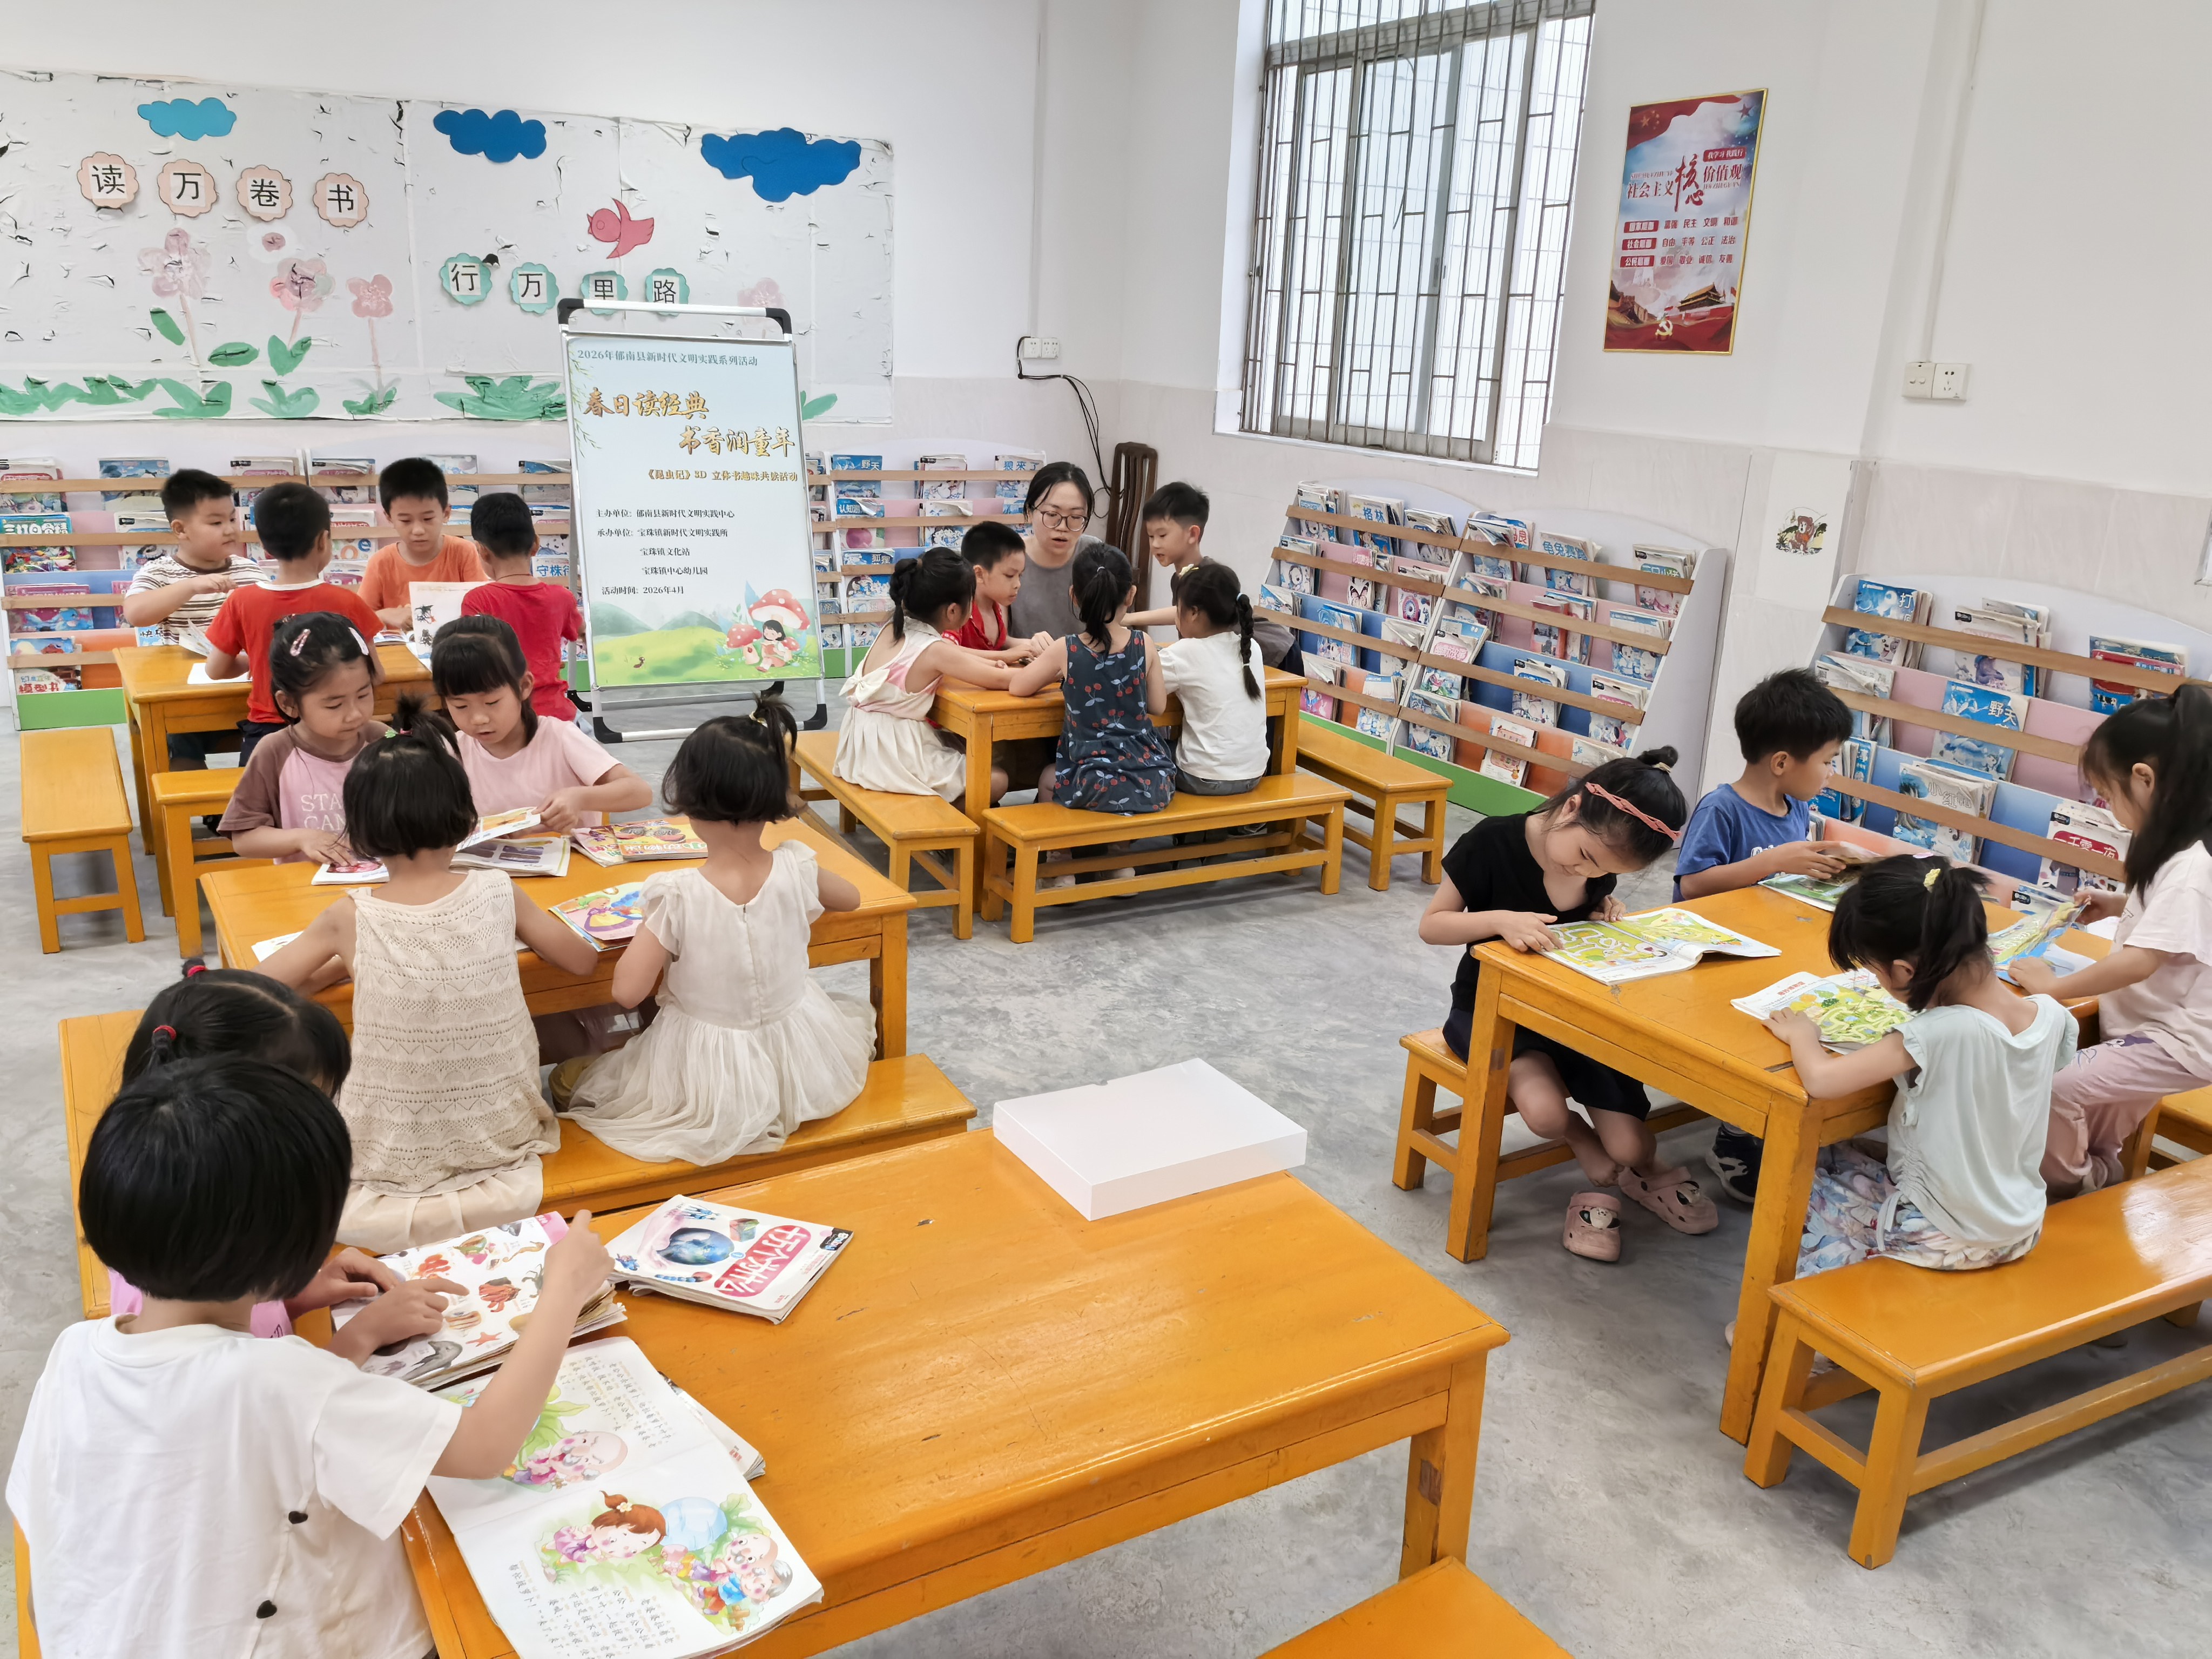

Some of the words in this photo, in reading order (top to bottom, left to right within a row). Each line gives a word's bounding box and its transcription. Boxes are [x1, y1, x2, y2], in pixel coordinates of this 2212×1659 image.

[92, 165, 354, 213] 读万卷书
[1628, 180, 1674, 199] 社会主义
[1675, 153, 1704, 212] 核心
[1703, 164, 1743, 183] 价值观
[1683, 219, 1697, 228] 民主
[1703, 218, 1718, 227] 文明
[1662, 238, 1676, 247] 自由
[1682, 237, 1696, 246] 平等
[1701, 236, 1715, 245] 公正
[1721, 235, 1736, 245] 法治
[451, 263, 677, 304] 行万里路
[577, 349, 758, 366] 2026年郁南县新时代文明实践系列活动
[583, 387, 709, 420] 春日读经典
[679, 425, 795, 457] 书香润童年
[639, 548, 690, 557] 宝珠镇文化站
[872, 554, 891, 564] 狐狸
[641, 567, 708, 576] 宝珠镇中心幼儿园
[716, 1226, 808, 1293] 十万个为什么
